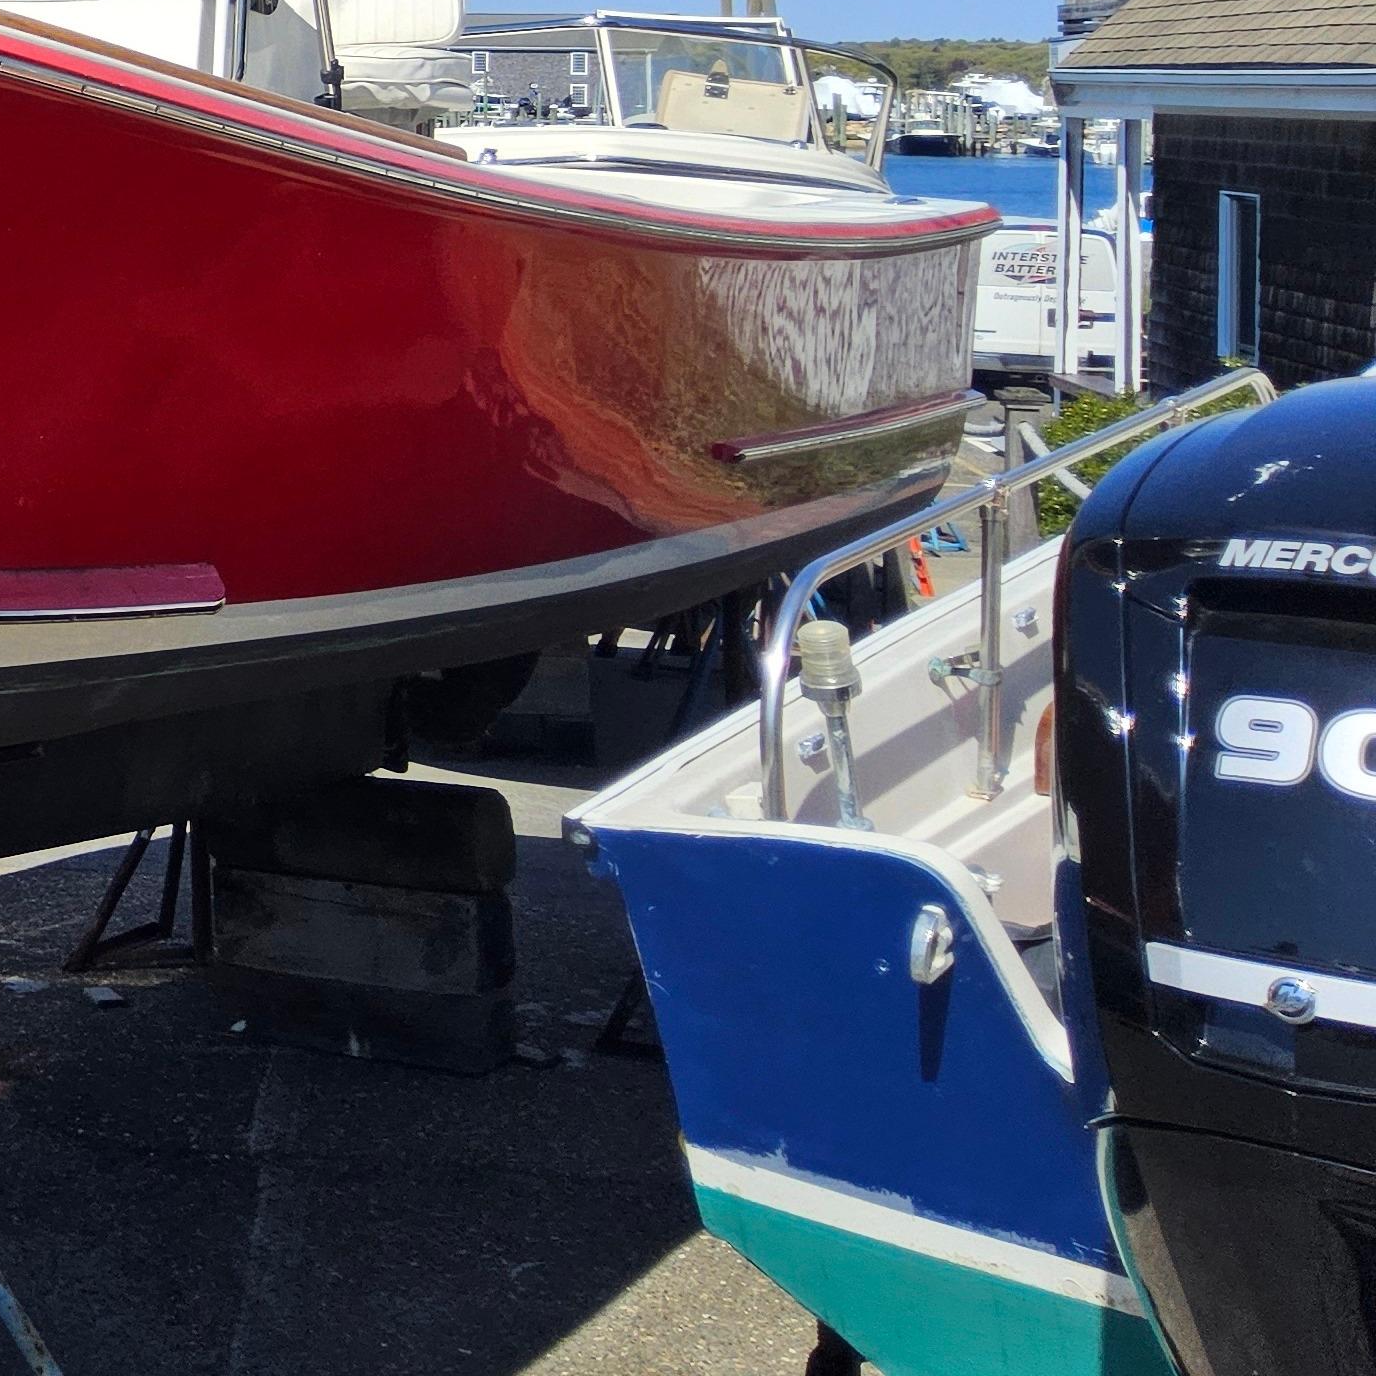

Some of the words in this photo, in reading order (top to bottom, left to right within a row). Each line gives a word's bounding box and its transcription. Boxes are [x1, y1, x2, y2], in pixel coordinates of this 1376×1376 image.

[991, 251, 1090, 265] INTERSTE
[994, 264, 1057, 275] BATTER
[1217, 538, 1376, 577] MERC
